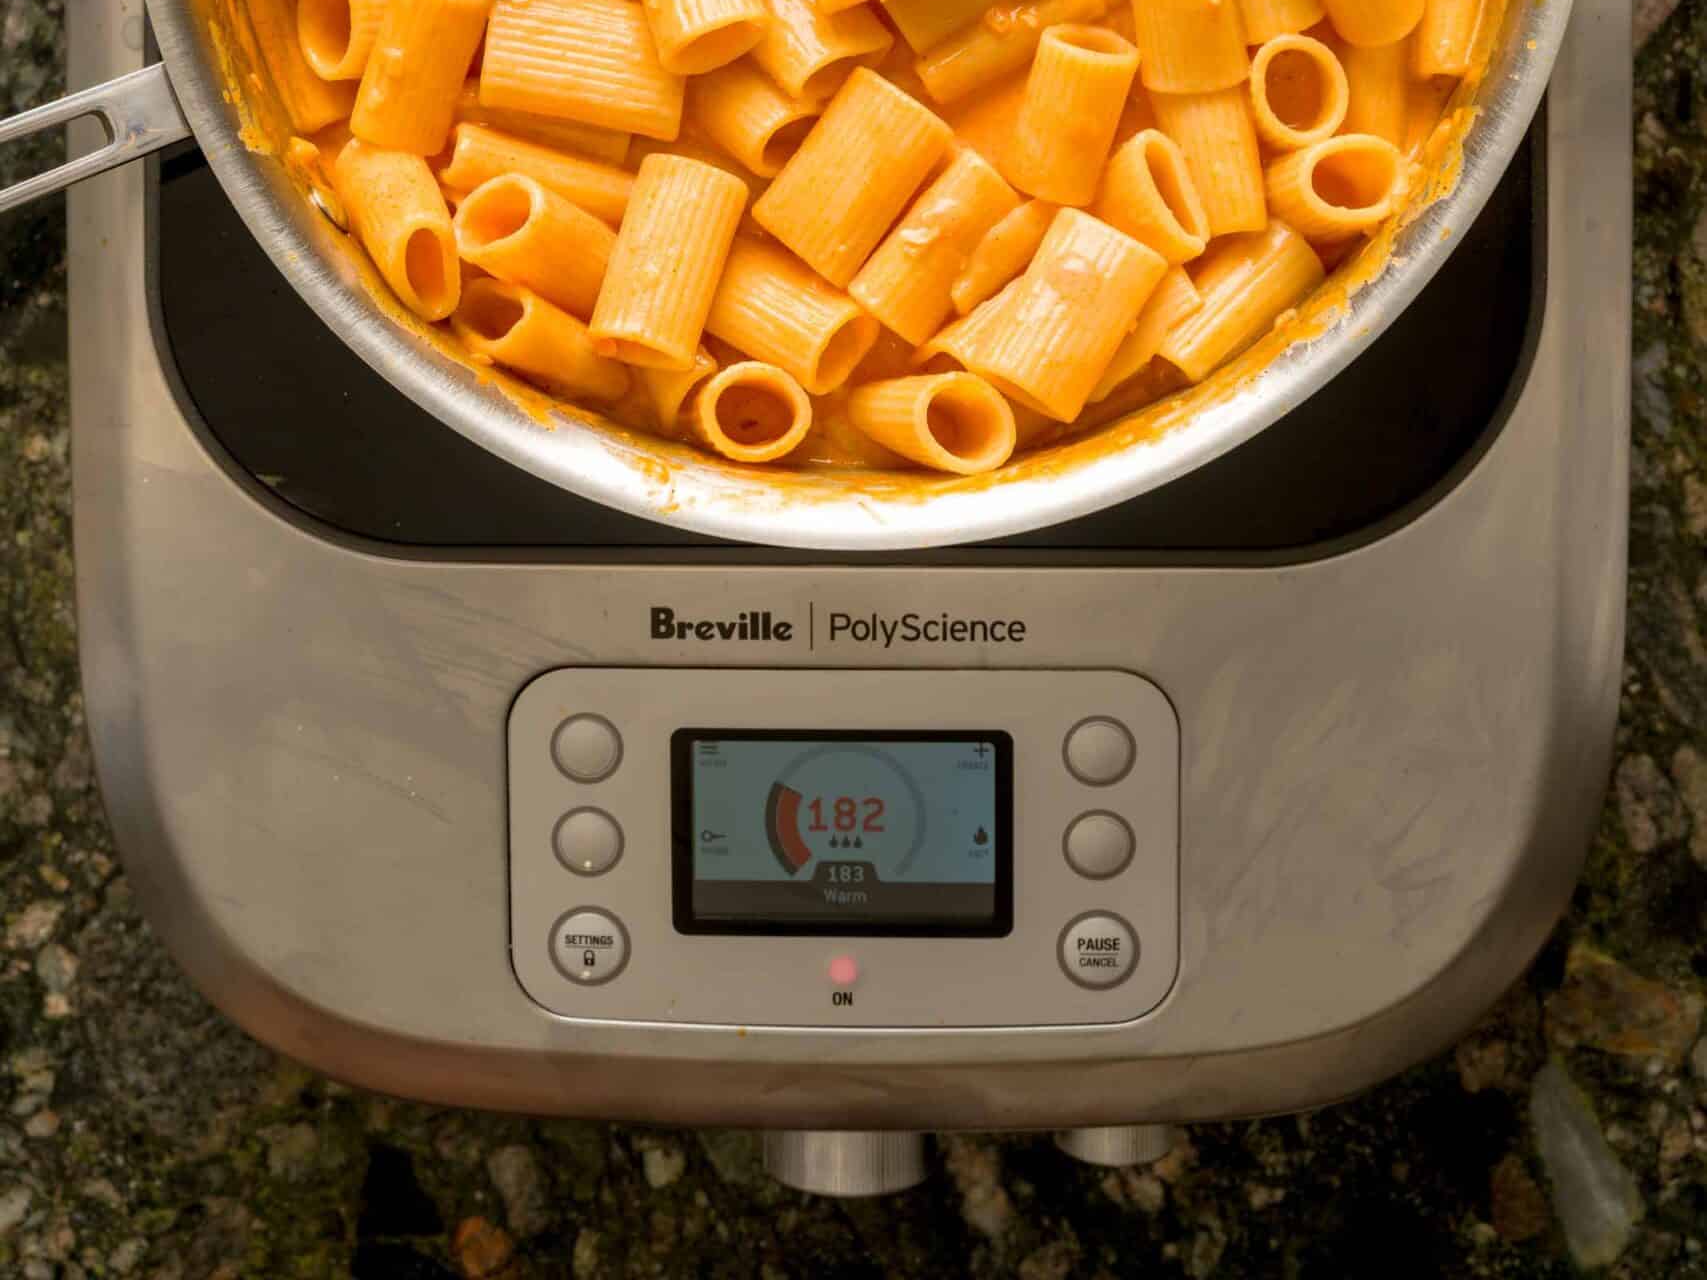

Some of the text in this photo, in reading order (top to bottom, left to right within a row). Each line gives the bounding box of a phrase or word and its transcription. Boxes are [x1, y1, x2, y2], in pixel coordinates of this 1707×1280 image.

[650, 607, 1027, 648] Breville PolyScience
[808, 797, 885, 832] 182
[828, 866, 865, 883] 183
[823, 888, 868, 904] Warm
[564, 934, 614, 945] SETTINGS
[1077, 937, 1121, 951] PAUSE
[1079, 957, 1120, 968] CANCEL
[831, 992, 853, 1007] ON
